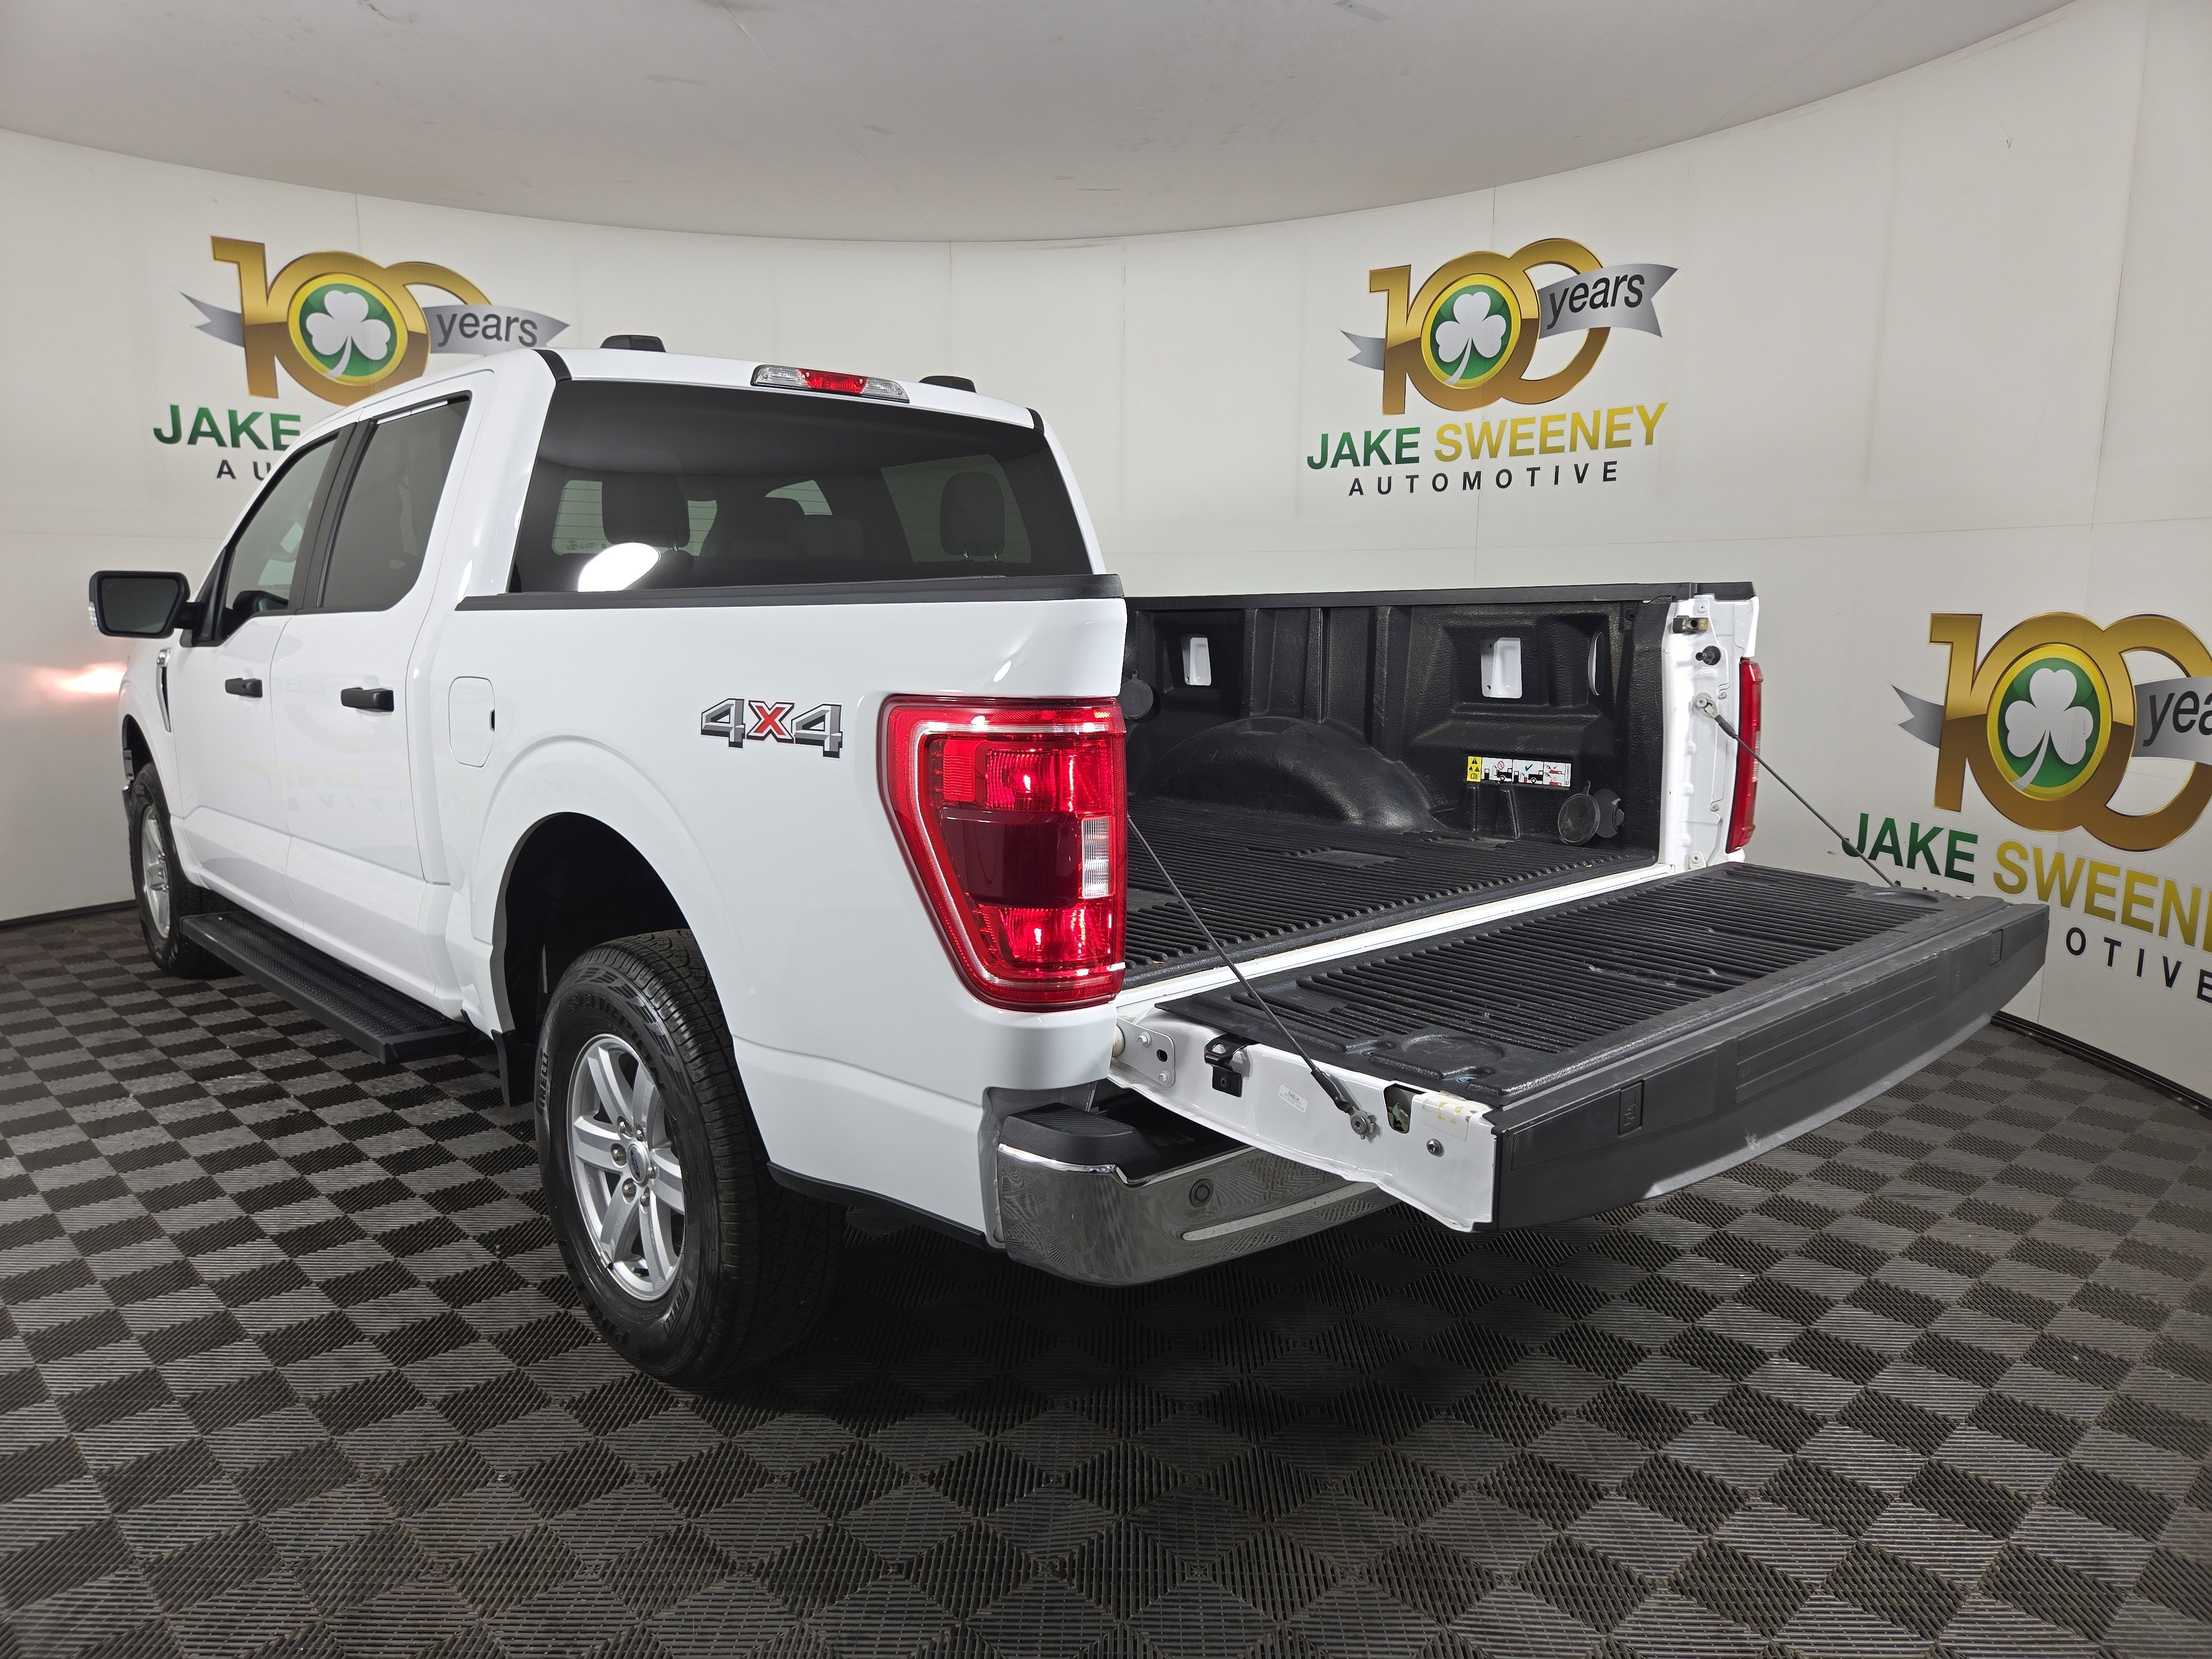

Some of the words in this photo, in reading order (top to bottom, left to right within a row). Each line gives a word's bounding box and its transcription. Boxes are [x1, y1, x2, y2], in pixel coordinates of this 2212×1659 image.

[436, 311, 538, 347] years
[1368, 237, 1611, 415] 100
[1546, 272, 1645, 330] years
[153, 404, 301, 451] JAKE
[1307, 426, 1420, 470] JAKE
[1435, 402, 1668, 462] SWEENEY
[1348, 460, 1618, 497] AUTOMOTIVE
[1842, 812, 1978, 884] JAKE
[1994, 840, 2212, 953] SWEEN
